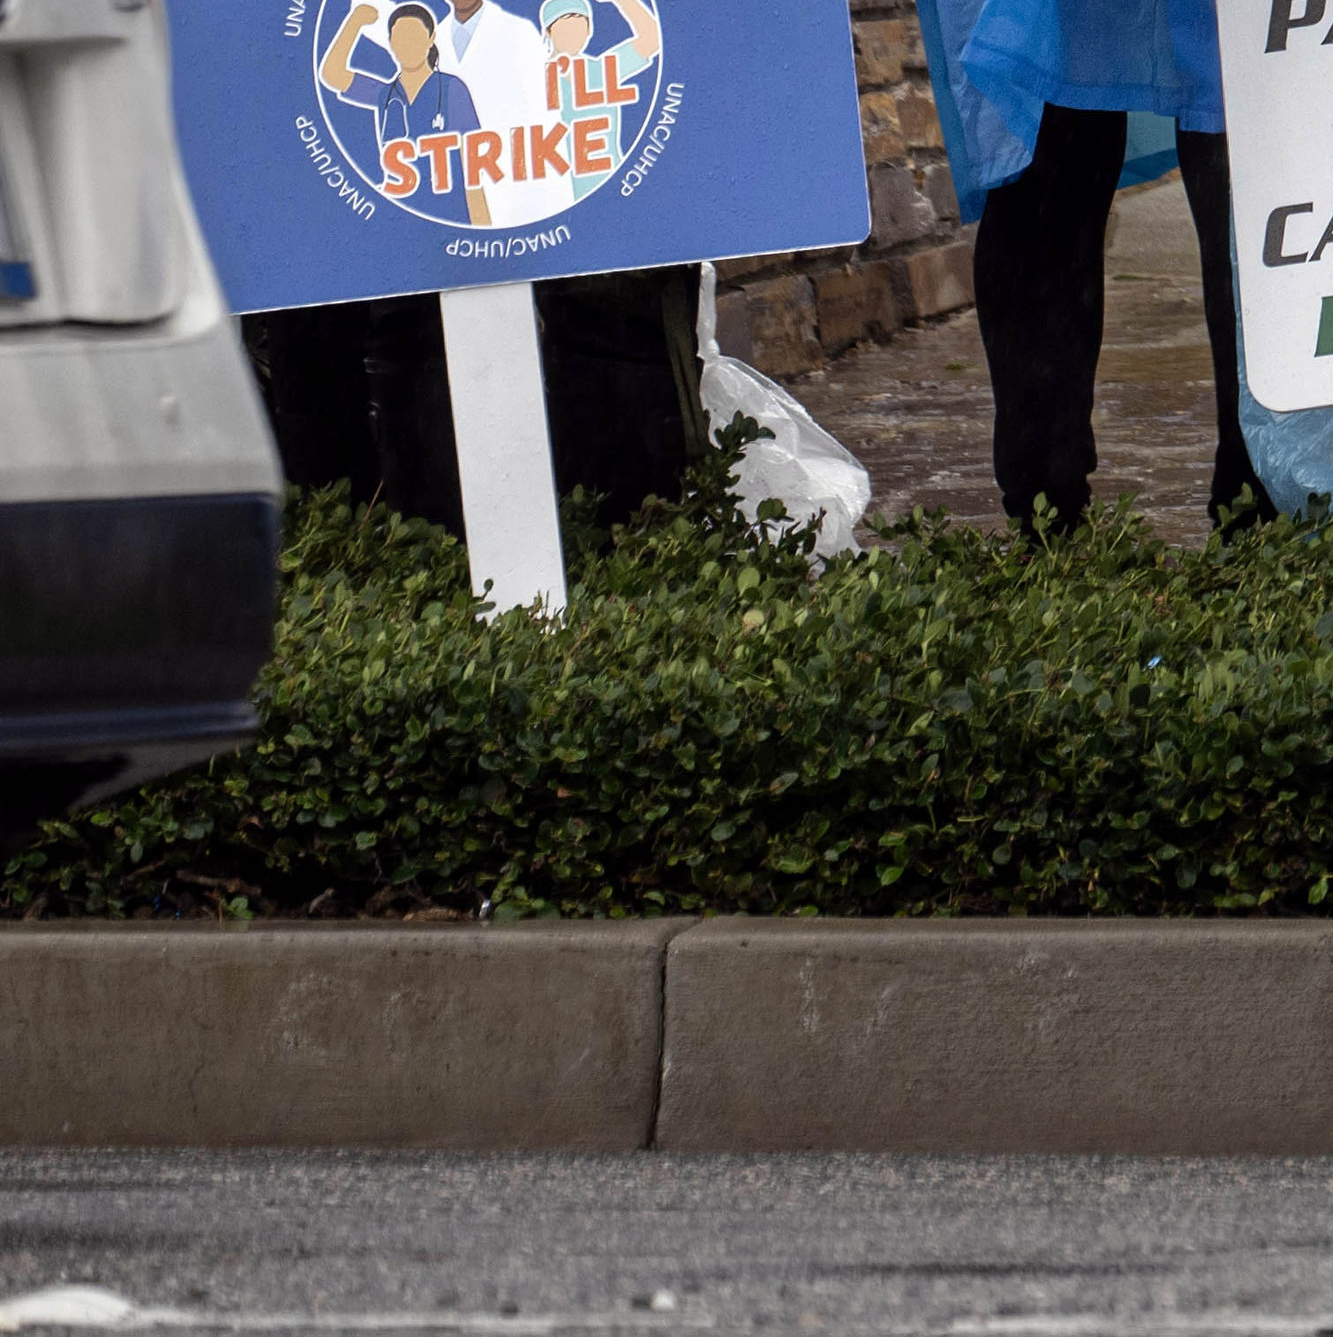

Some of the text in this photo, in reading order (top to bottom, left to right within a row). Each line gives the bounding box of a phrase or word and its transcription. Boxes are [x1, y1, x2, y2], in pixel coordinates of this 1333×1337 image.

[545, 54, 637, 111] I'LL
[296, 115, 376, 221] UNAC/UHCP
[382, 117, 612, 195] STRIKE
[621, 82, 684, 197] UNAC/UHCP
[446, 225, 572, 258] UNAC/UHCP
